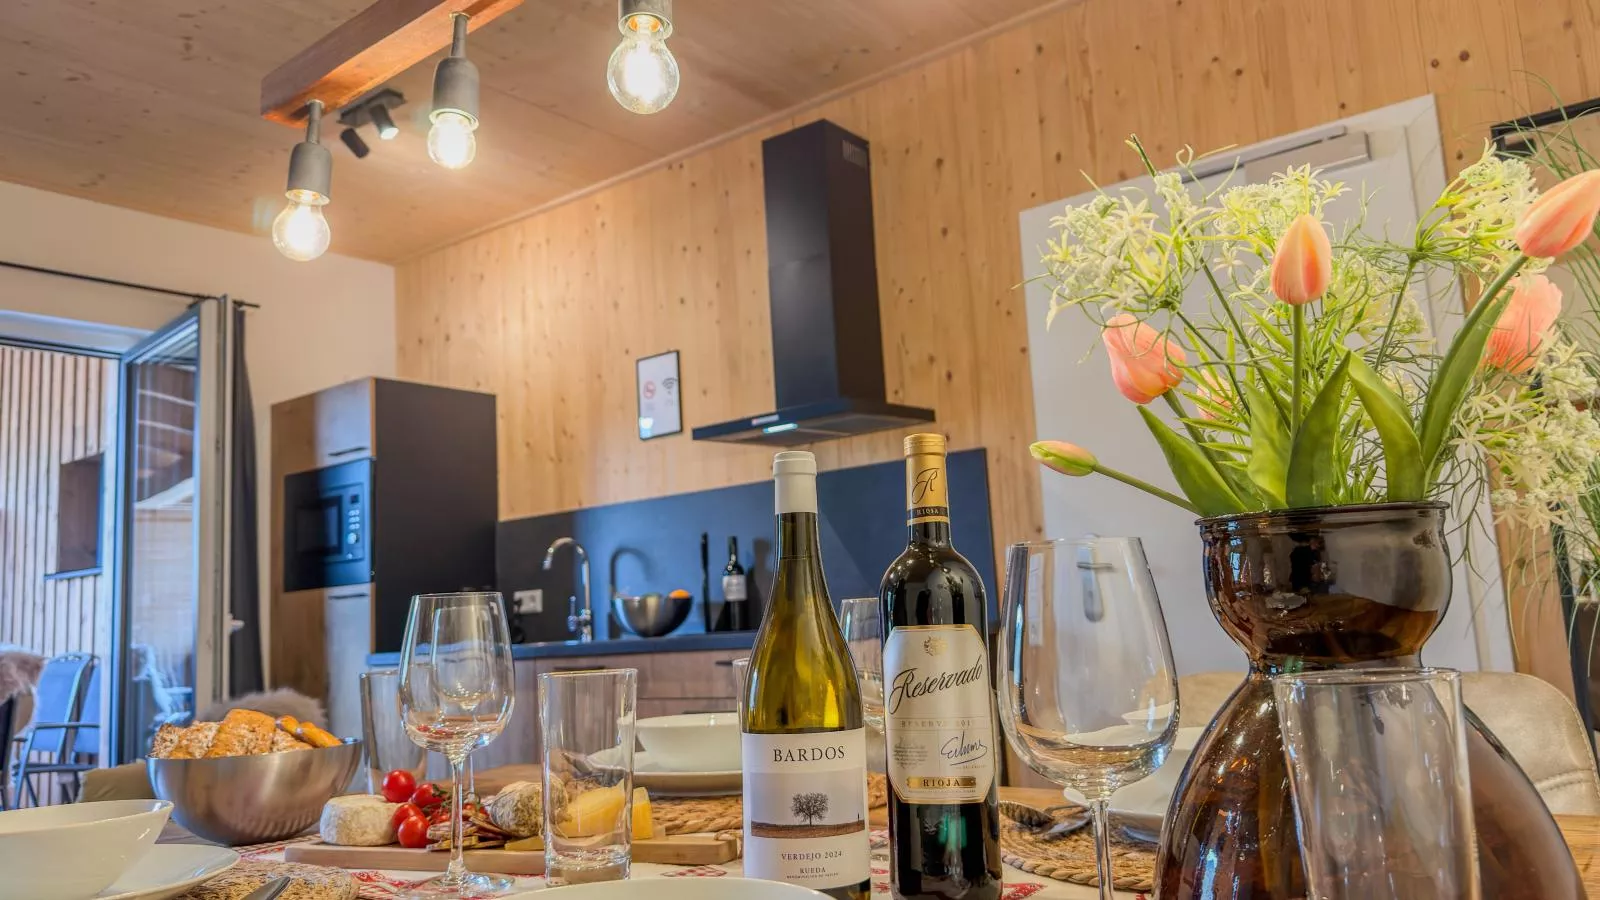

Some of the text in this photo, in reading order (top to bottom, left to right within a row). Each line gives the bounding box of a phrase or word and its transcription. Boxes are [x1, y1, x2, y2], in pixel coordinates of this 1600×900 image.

[888, 654, 983, 715] Reservado
[773, 746, 845, 761] BARDOS
[923, 779, 961, 787] RIOJA
[781, 853, 821, 861] VERDEJO
